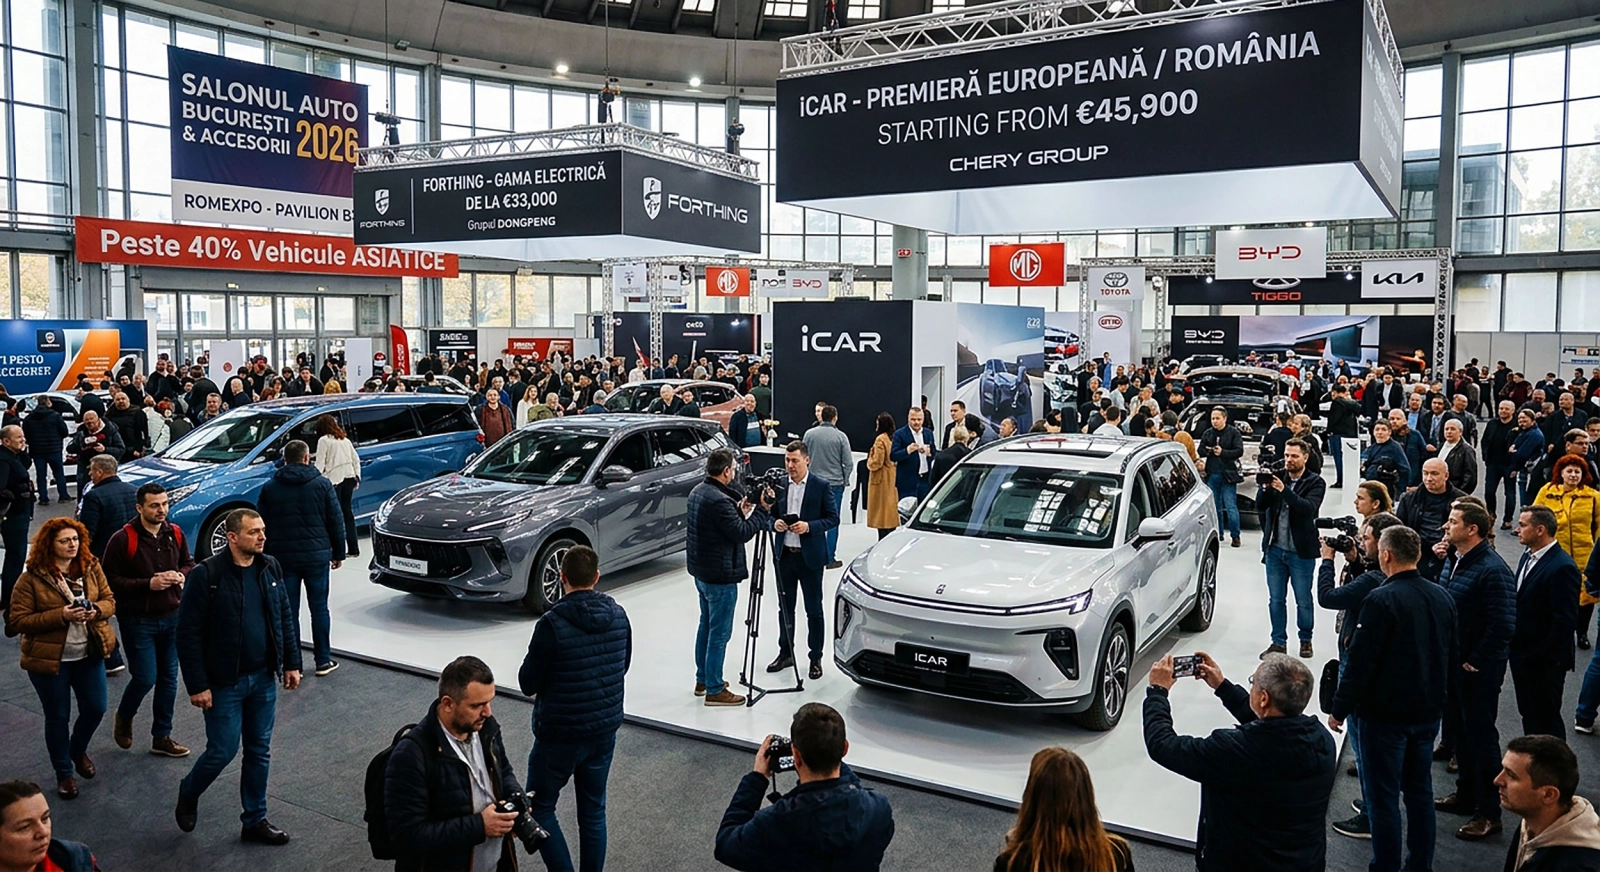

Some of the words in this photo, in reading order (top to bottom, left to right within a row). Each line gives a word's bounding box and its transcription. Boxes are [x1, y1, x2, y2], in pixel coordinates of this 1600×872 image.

[800, 92, 847, 117] iCAR
[867, 69, 982, 109] PREMIERĂ
[988, 46, 1147, 95] EUROPEANĂ
[1153, 49, 1167, 80] /
[1174, 31, 1321, 73] ROMÂNIA
[182, 72, 294, 112] SALONUL
[298, 96, 359, 122] AUTO
[182, 100, 289, 134] BUCUREȘTI
[878, 112, 989, 145] STARTING
[997, 104, 1068, 133] FROM
[1076, 89, 1198, 125] €45,900
[182, 125, 196, 142] &
[200, 128, 290, 155] ACCESORII
[295, 119, 359, 163] 2026
[950, 152, 1022, 172] CHERY
[1028, 145, 1109, 166] GROUP
[423, 174, 484, 192] FORTHING
[494, 170, 532, 187] GAMA
[535, 161, 606, 184] ELECTRICĂ
[184, 193, 262, 214] ROMEXPO
[275, 203, 339, 221] PAVILION
[343, 209, 355, 222] B
[466, 196, 482, 210] DE
[485, 195, 500, 209] LA
[503, 191, 558, 210] €33,000
[668, 193, 748, 224] FORTHING
[497, 216, 556, 229] DONGPENG
[100, 229, 181, 257] Peste
[188, 235, 242, 261] 40%
[247, 239, 346, 266] Vehicule
[351, 246, 446, 271] ASIATICE
[1238, 245, 1302, 260] BYD
[1011, 250, 1040, 280] MG
[1373, 272, 1424, 285] KIA
[1100, 288, 1131, 296] TOYOTA
[1251, 291, 1301, 301] TIGGO
[801, 324, 882, 352] iCAR
[10, 355, 44, 365] PESTO
